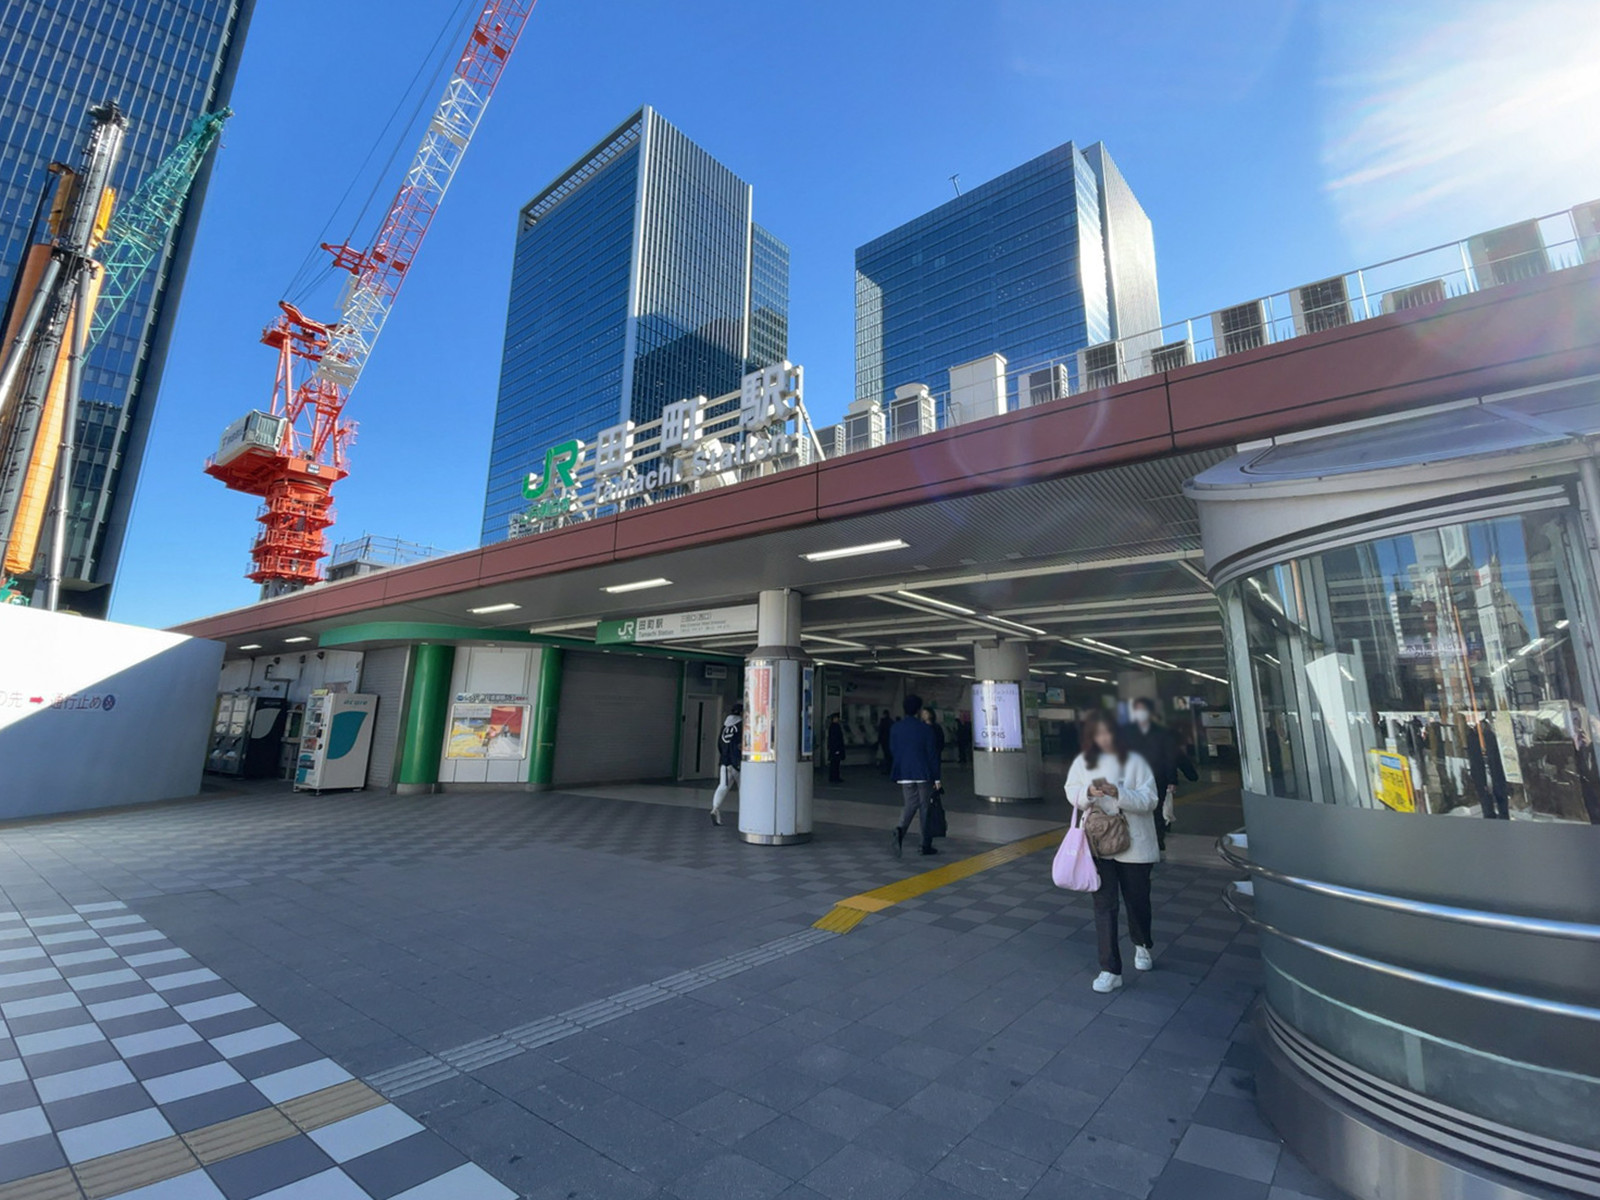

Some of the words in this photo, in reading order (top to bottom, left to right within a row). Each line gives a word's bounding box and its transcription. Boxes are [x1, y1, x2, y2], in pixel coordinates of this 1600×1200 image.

[595, 361, 792, 475] 田町駅
[522, 439, 581, 499] JR
[593, 457, 680, 502] Tamachi
[693, 433, 790, 477] Station
[618, 621, 635, 635] JR
[639, 618, 664, 631] 田町駅
